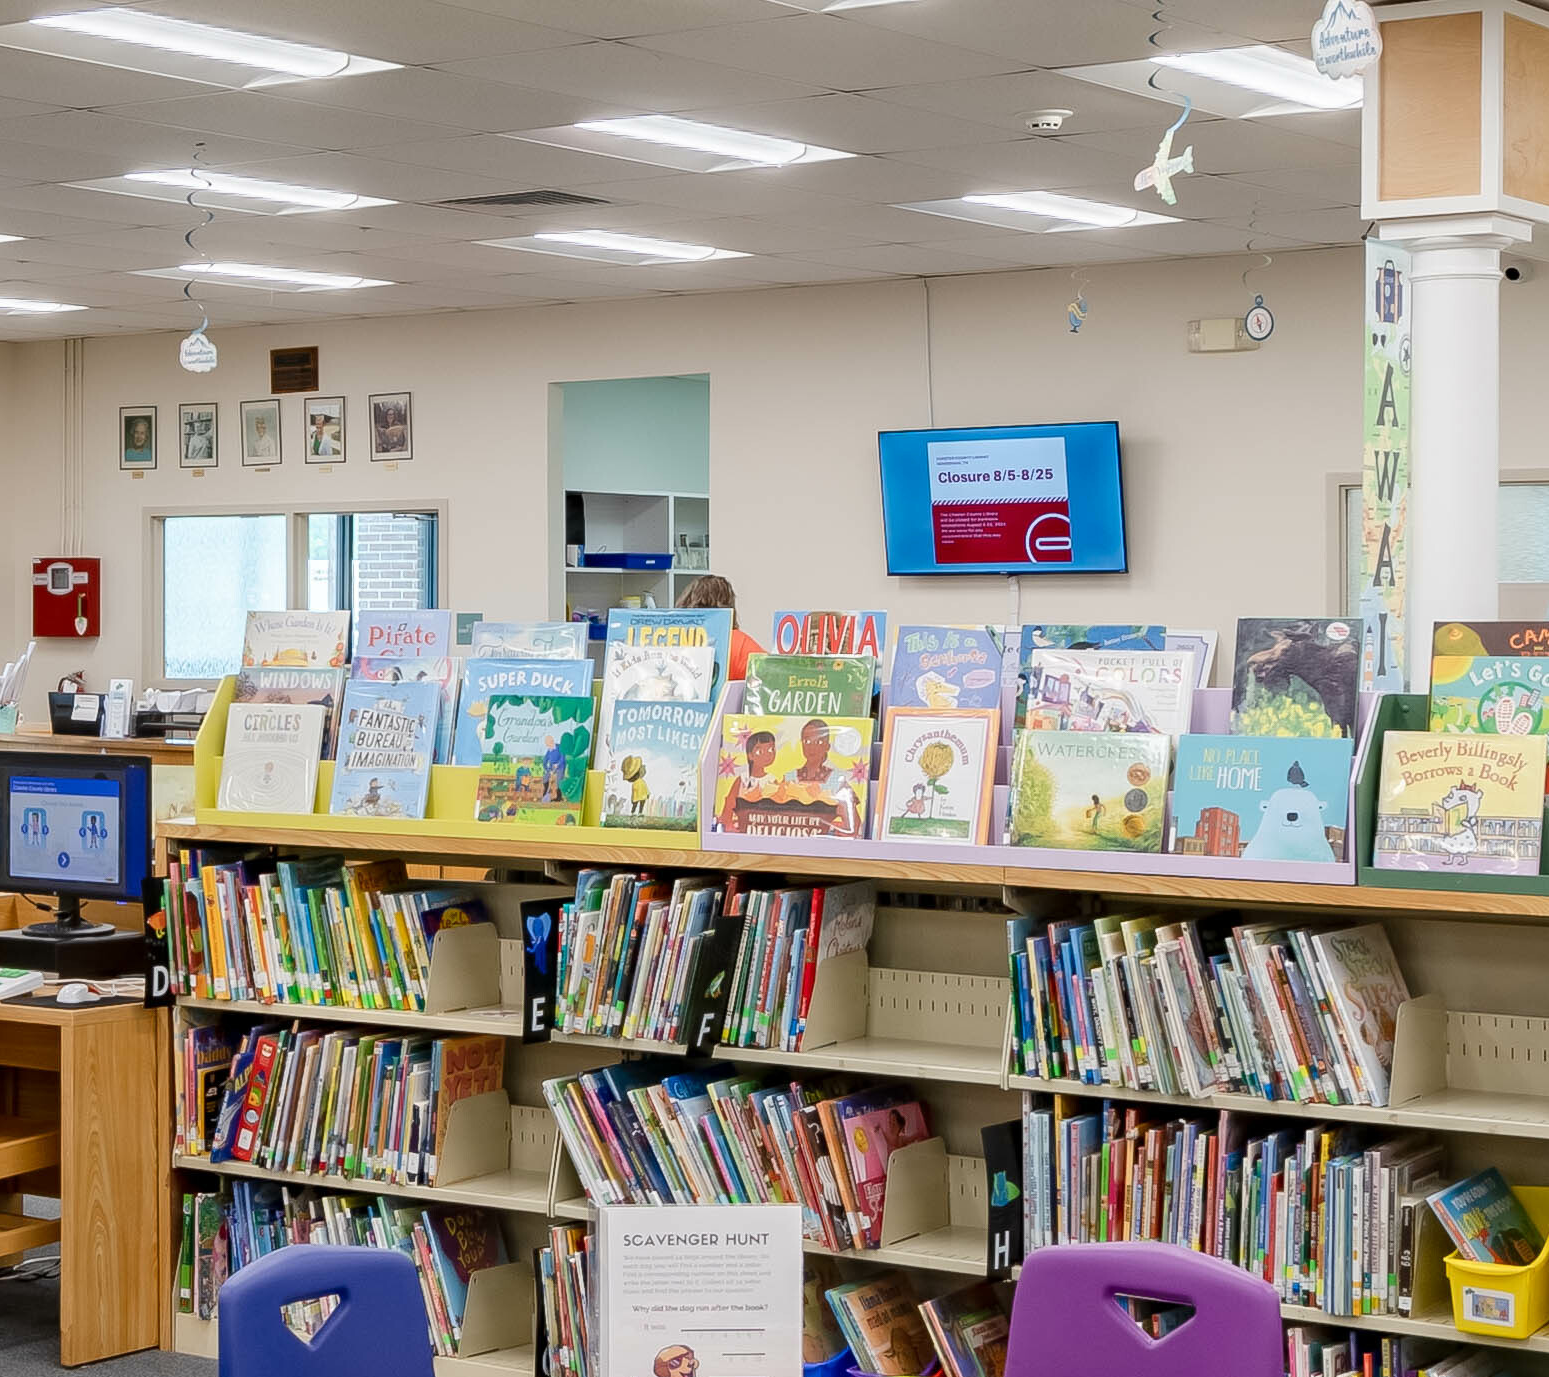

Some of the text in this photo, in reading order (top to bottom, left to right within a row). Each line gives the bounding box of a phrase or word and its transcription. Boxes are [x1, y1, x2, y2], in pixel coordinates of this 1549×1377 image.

[938, 468, 1054, 484] Closure 8/5-8/25
[368, 623, 436, 647] Pirate
[627, 626, 707, 647] LEGEND
[776, 614, 879, 658] OLIVIA
[260, 672, 332, 689] WINDOWS
[479, 671, 575, 694] SUPER DUCK
[1095, 667, 1183, 684] COLORS
[1469, 660, 1521, 687] Let's
[768, 690, 842, 714] GARDEN
[244, 714, 302, 732] CIRCLES
[359, 710, 416, 734] FANTASTIC
[617, 704, 710, 728] TOMORROW
[357, 731, 403, 748] BUREAU
[615, 725, 705, 750] MOST LIKELY
[905, 727, 969, 767] Chrysanthemum
[351, 751, 416, 767] IMAGINATION
[1397, 742, 1452, 767] Beverly
[1457, 741, 1527, 774] Billingsly
[1217, 766, 1263, 791] HOME
[1401, 764, 1518, 792] Borrows a Book
[153, 965, 168, 997] D
[532, 996, 546, 1032] E
[696, 1012, 715, 1047] F
[446, 1045, 501, 1074] NOT
[623, 1232, 770, 1246] SCAVENGER HUNT
[994, 1230, 1010, 1269] H
[1399, 1249, 1411, 1268] egg
[632, 1305, 650, 1313] Why
[680, 1305, 695, 1313] dog
[731, 1304, 744, 1312] the
[745, 1304, 769, 1312] book?
